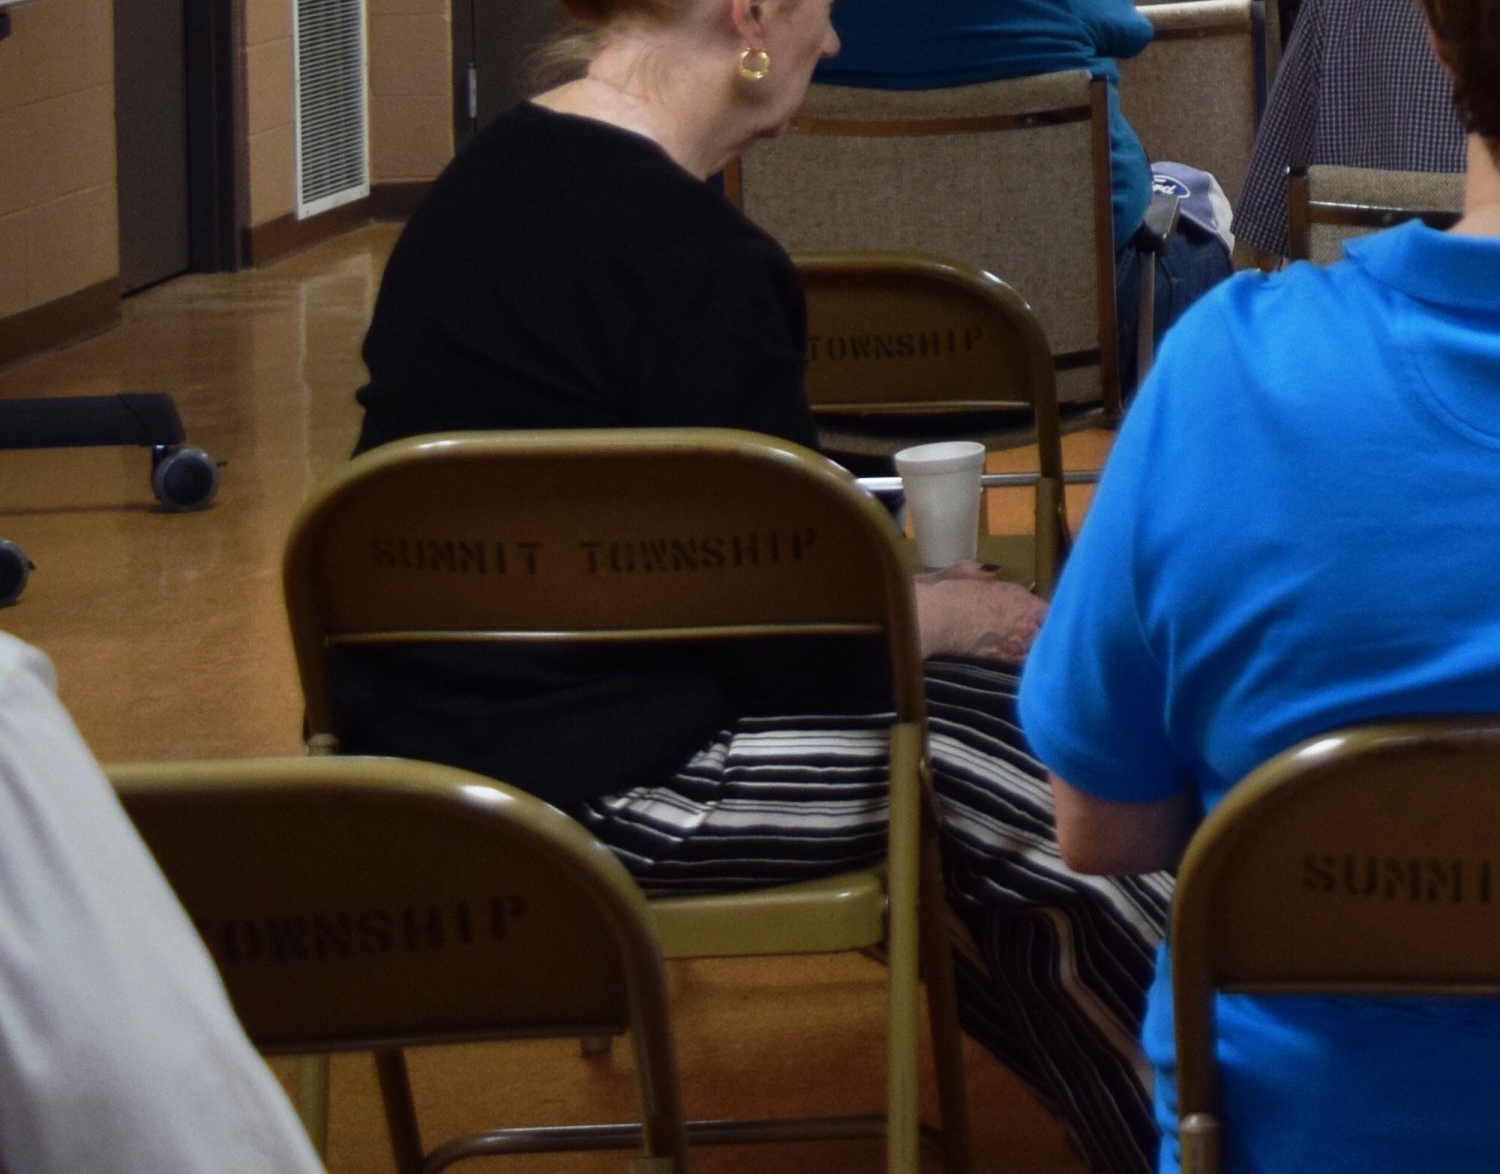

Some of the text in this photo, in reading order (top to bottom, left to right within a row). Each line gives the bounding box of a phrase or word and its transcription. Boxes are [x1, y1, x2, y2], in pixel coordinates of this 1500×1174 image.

[808, 326, 984, 362] TOWNSHIP
[369, 526, 819, 575] SUMMIT TOWNSHIP
[208, 894, 529, 964] OWNSHIP
